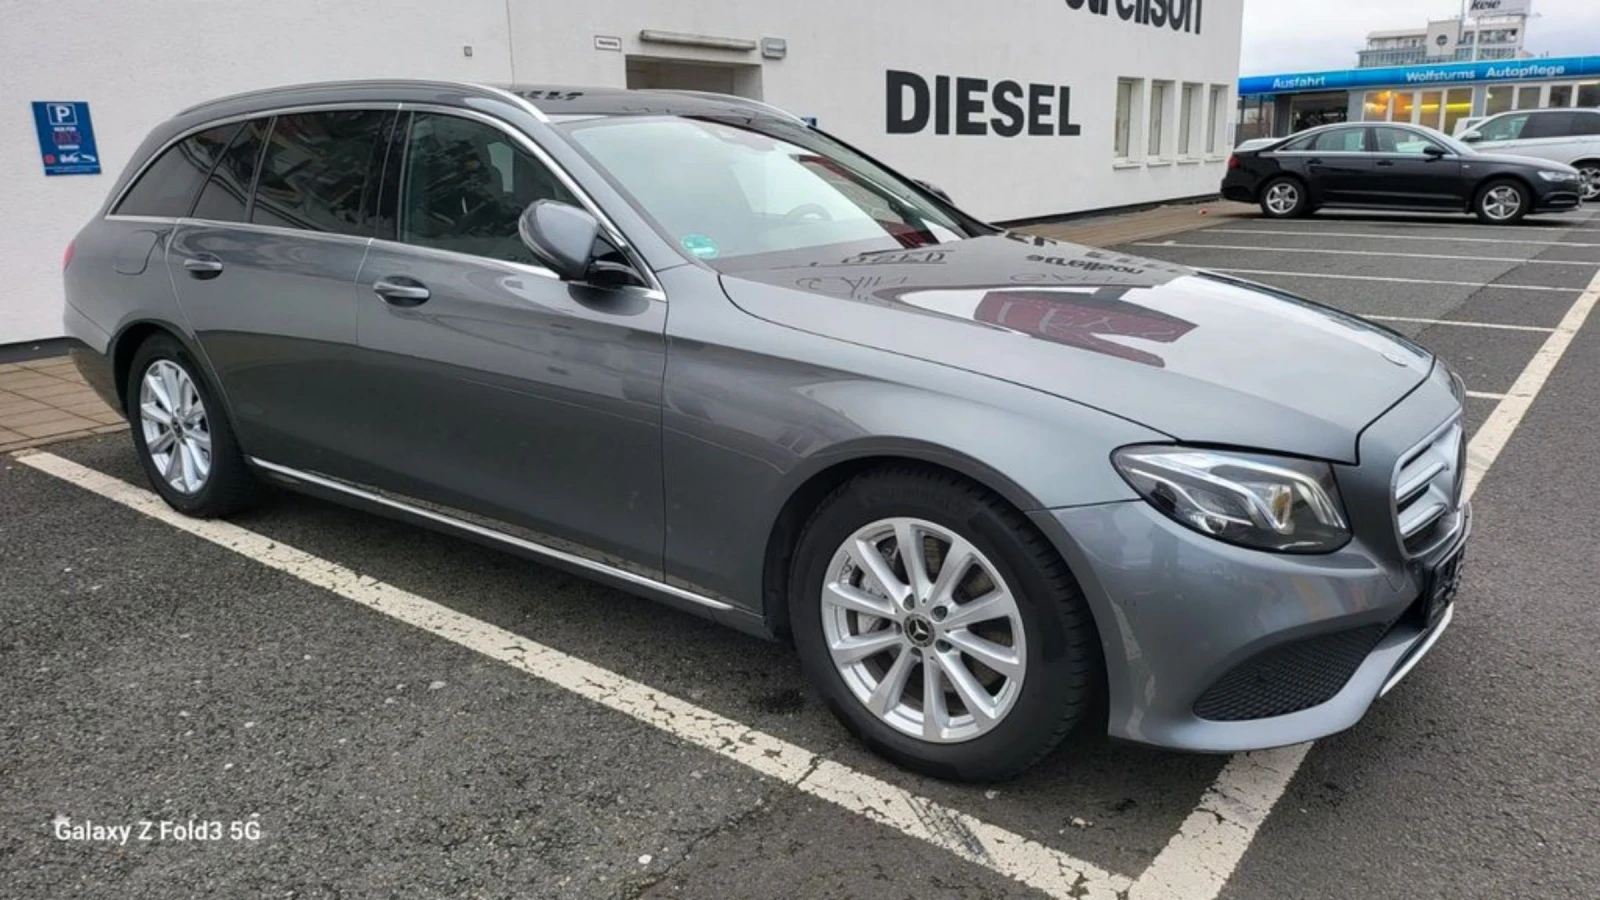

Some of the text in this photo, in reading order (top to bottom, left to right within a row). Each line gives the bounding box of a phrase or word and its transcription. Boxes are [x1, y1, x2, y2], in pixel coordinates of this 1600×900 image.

[1406, 65, 1565, 82] Wolfsturms Autopflege
[1273, 76, 1326, 89] Ausfahrt
[886, 69, 1081, 138] DIESEL
[56, 106, 70, 122] P
